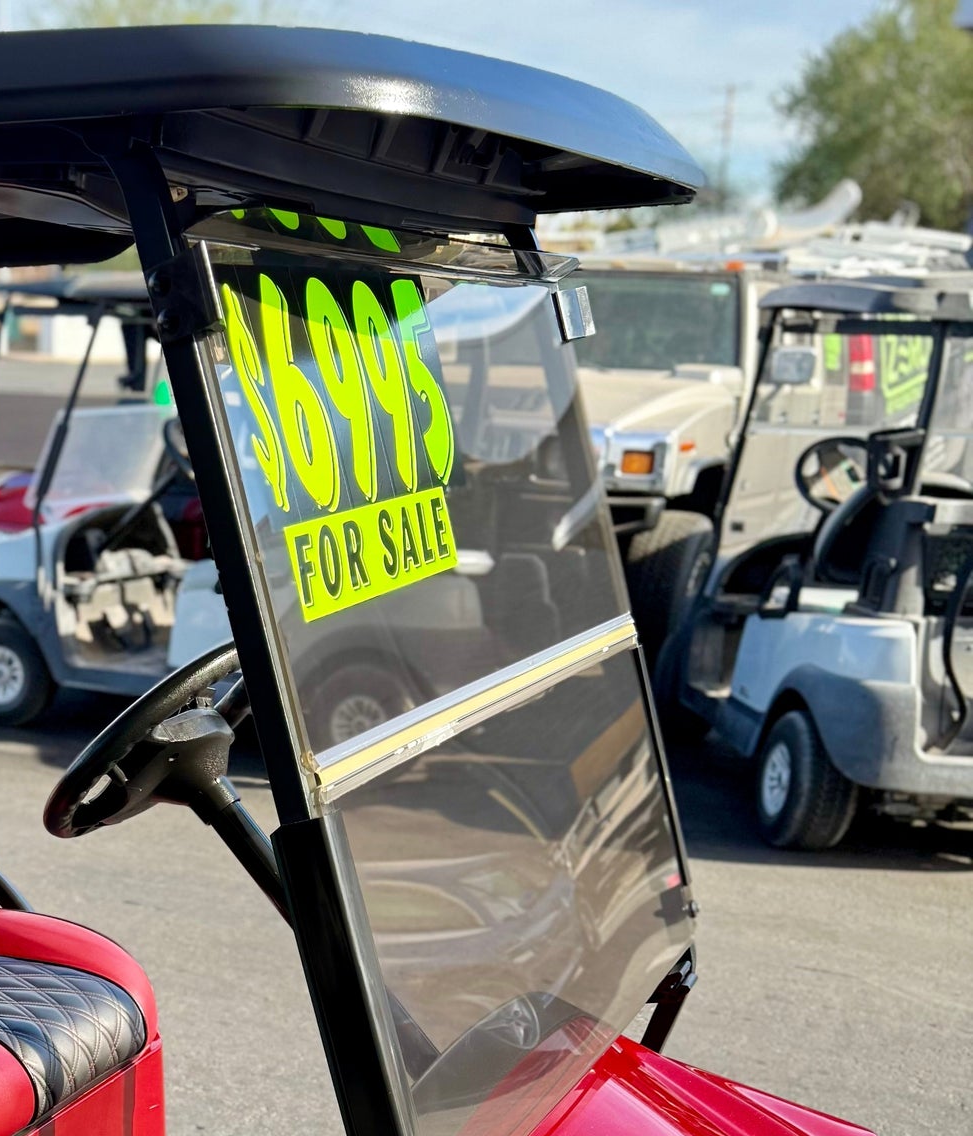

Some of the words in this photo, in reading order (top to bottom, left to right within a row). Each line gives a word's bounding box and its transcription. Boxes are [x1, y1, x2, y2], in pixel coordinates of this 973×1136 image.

[222, 273, 454, 512] $6995
[294, 520, 371, 608] FOR
[377, 497, 451, 580] SALE
